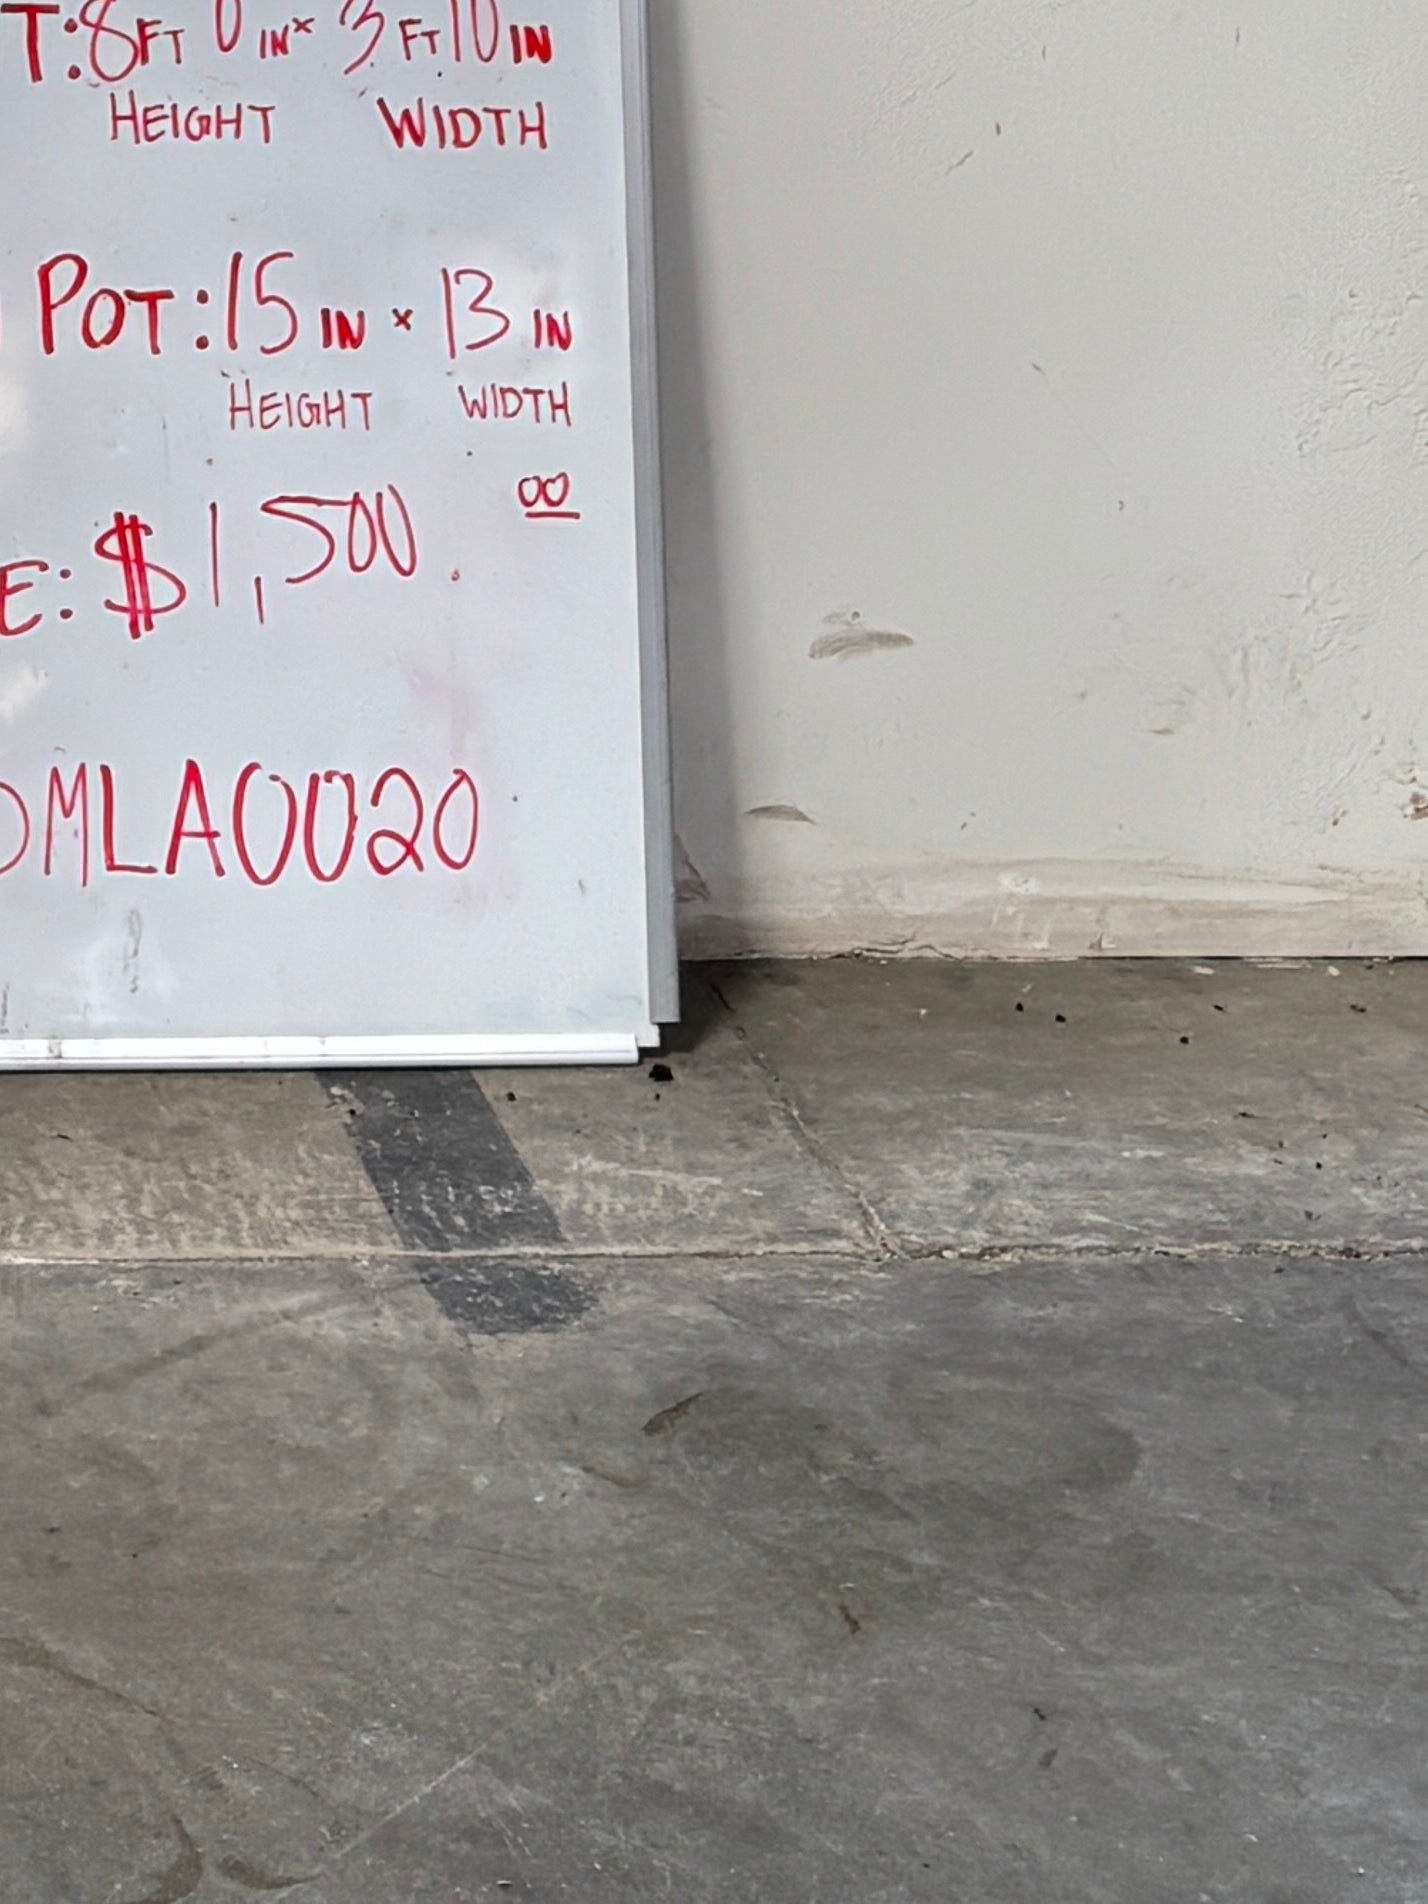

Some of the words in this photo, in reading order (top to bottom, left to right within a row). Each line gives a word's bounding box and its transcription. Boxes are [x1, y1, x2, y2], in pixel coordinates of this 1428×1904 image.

[109, 91, 277, 145] HEIGHT
[376, 97, 548, 150] WIDTH
[35, 252, 211, 357] POT:
[228, 383, 375, 432] HEIGHT
[457, 382, 572, 427] WIDTH
